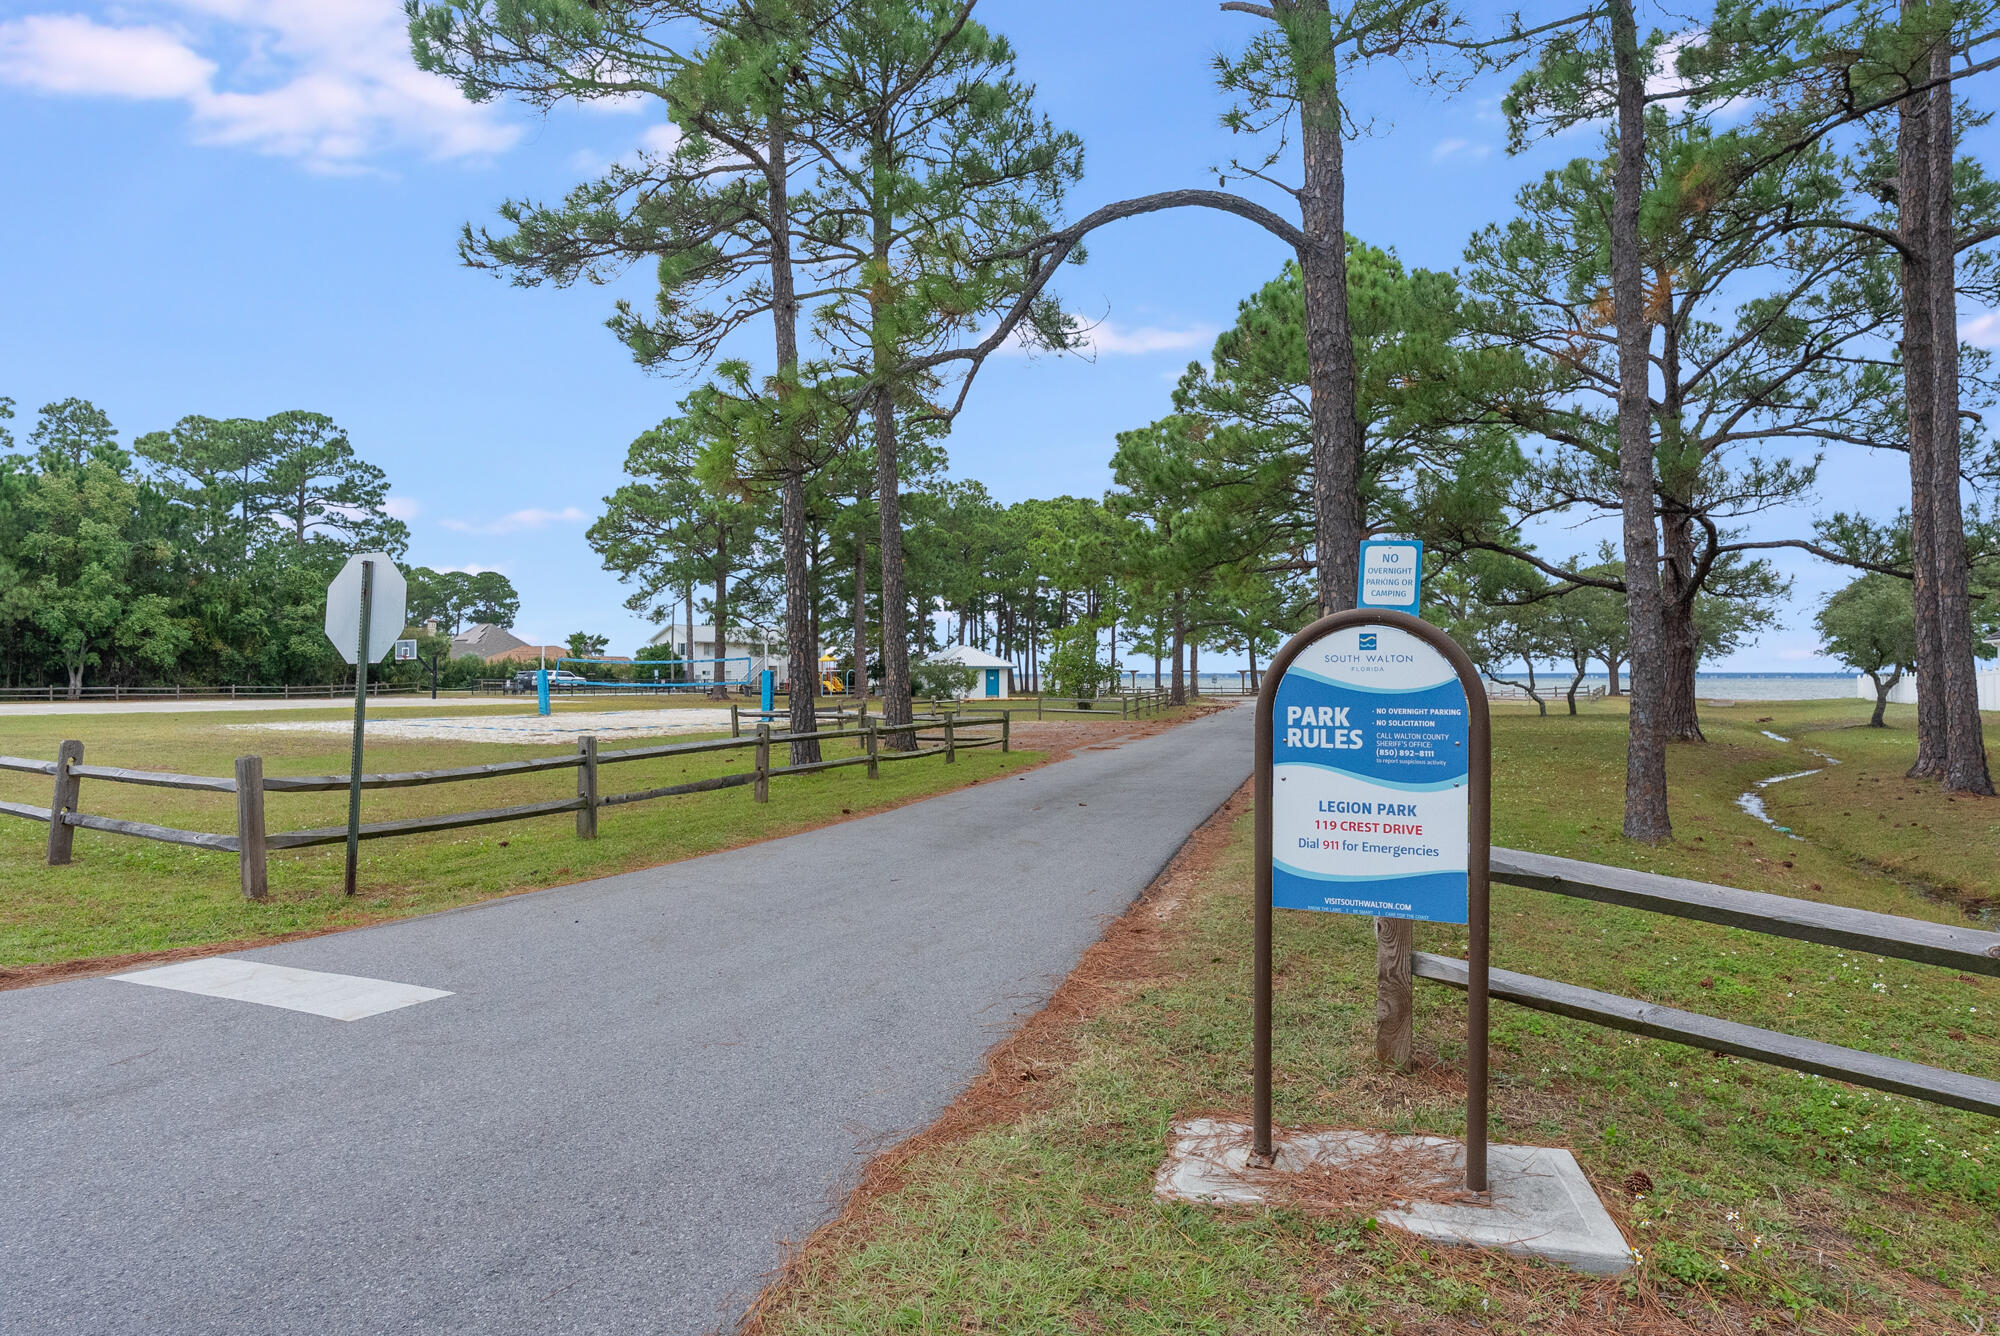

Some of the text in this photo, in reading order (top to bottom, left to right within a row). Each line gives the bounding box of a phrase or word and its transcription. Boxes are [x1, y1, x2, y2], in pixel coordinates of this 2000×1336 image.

[1383, 554, 1399, 563] NO
[1288, 706, 1350, 727] PARK
[1288, 728, 1363, 749] RULES
[1376, 749, 1397, 757] (850)
[1319, 801, 1417, 816] LEGION PARK
[1315, 820, 1423, 835] 119 CREST DRIVE
[1298, 838, 1439, 857] Dial 911 for Emergencies
[1325, 897, 1411, 911] VISITSOUTHWALTON.COM
